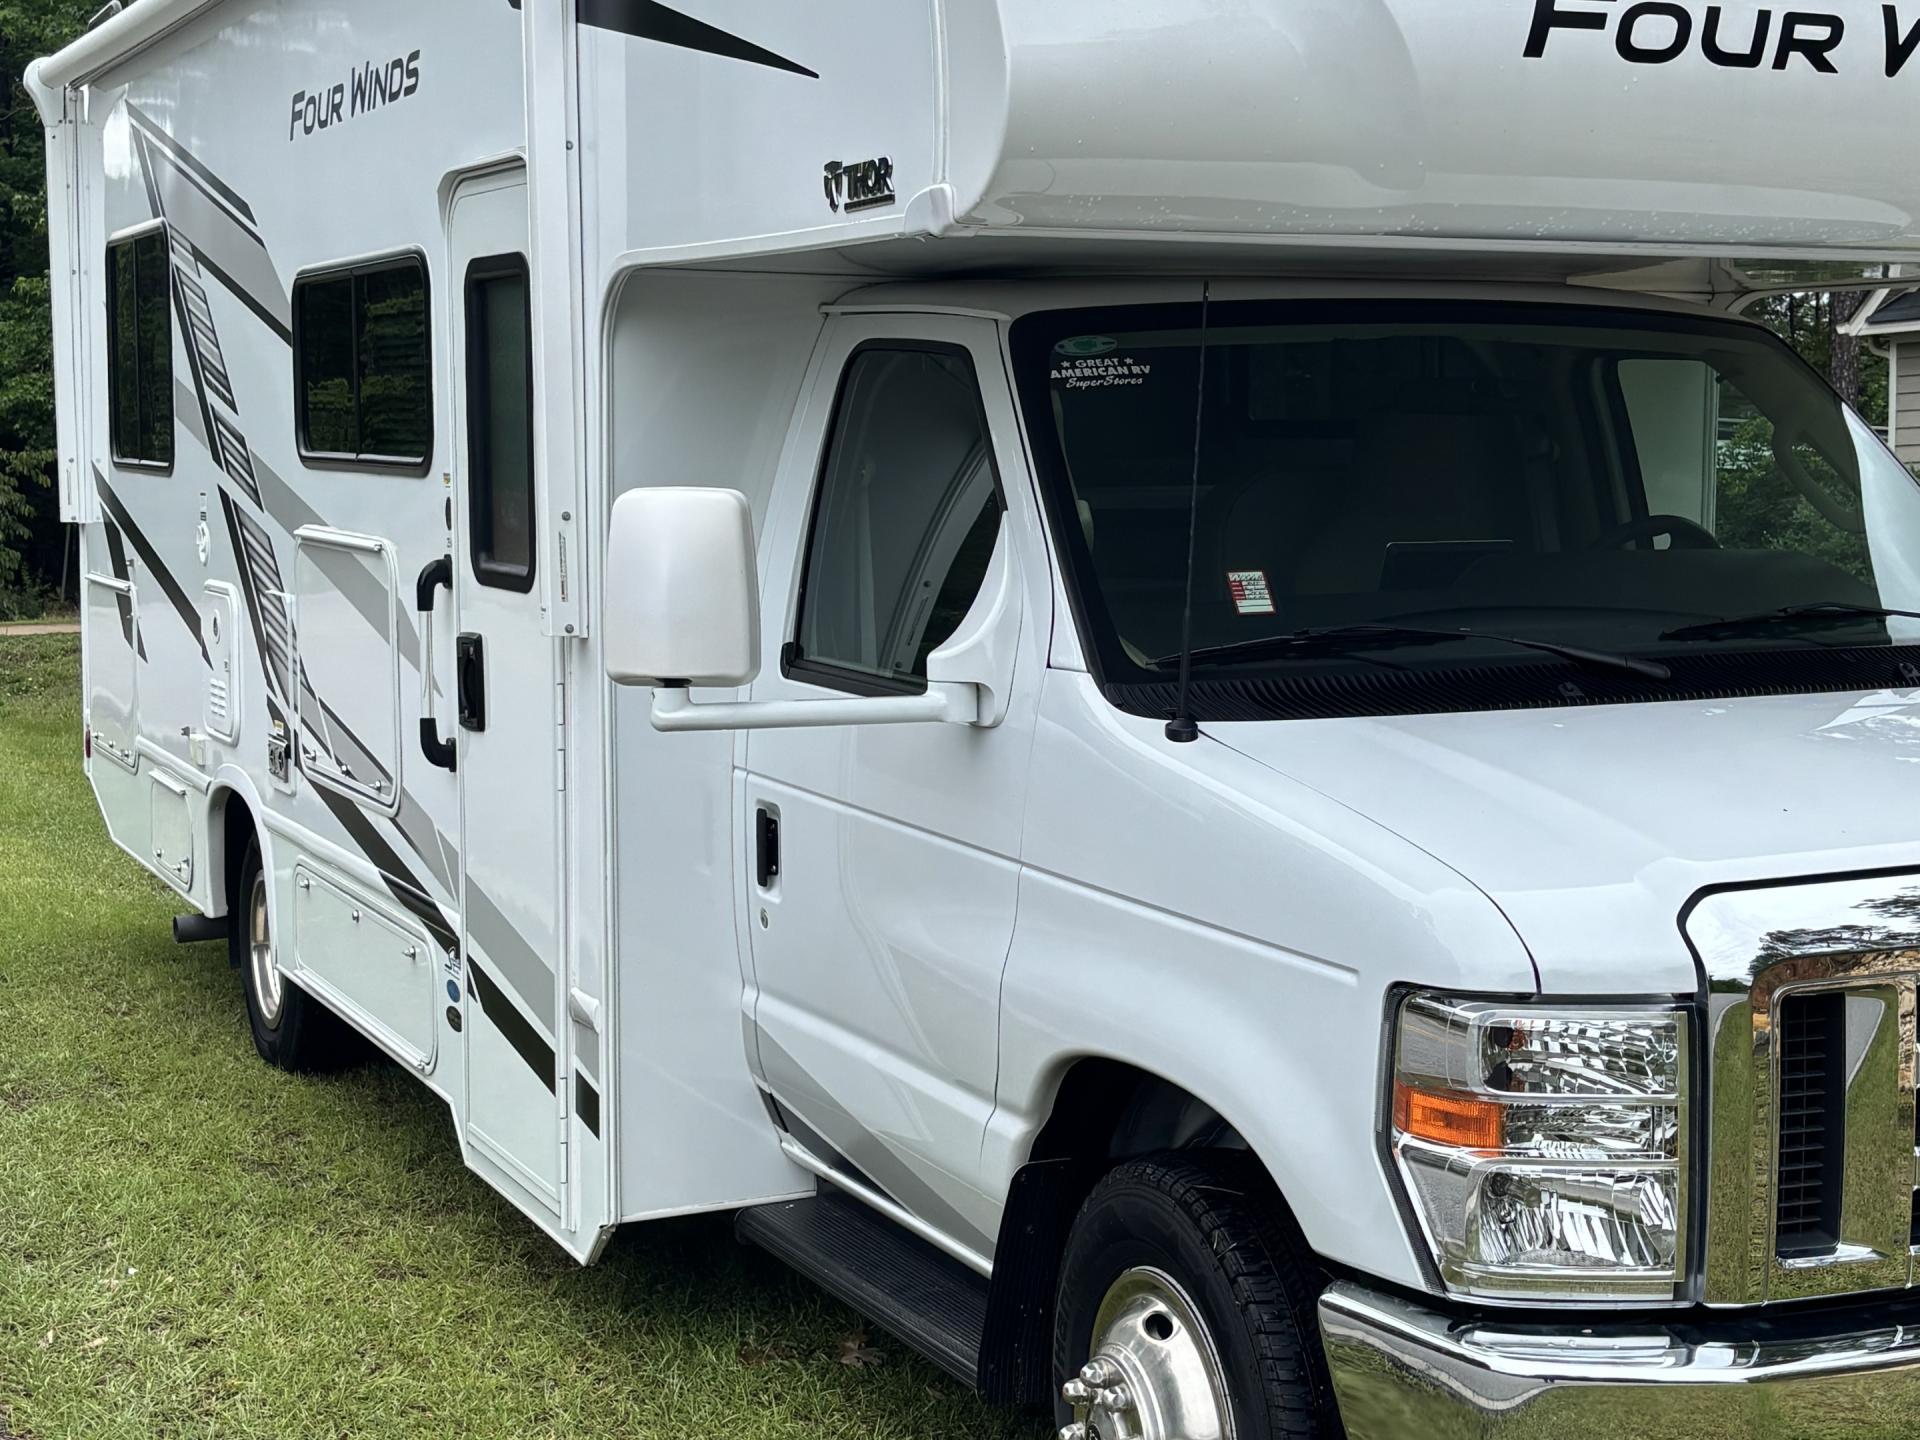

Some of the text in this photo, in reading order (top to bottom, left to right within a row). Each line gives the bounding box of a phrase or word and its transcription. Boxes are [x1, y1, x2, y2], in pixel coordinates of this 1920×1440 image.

[1523, 0, 1845, 74] FOUR
[289, 49, 421, 142] FOUR WINDS
[842, 156, 895, 201] THOR
[1050, 365, 1150, 379] AMERICAN RV
[1075, 358, 1119, 368] GREAT
